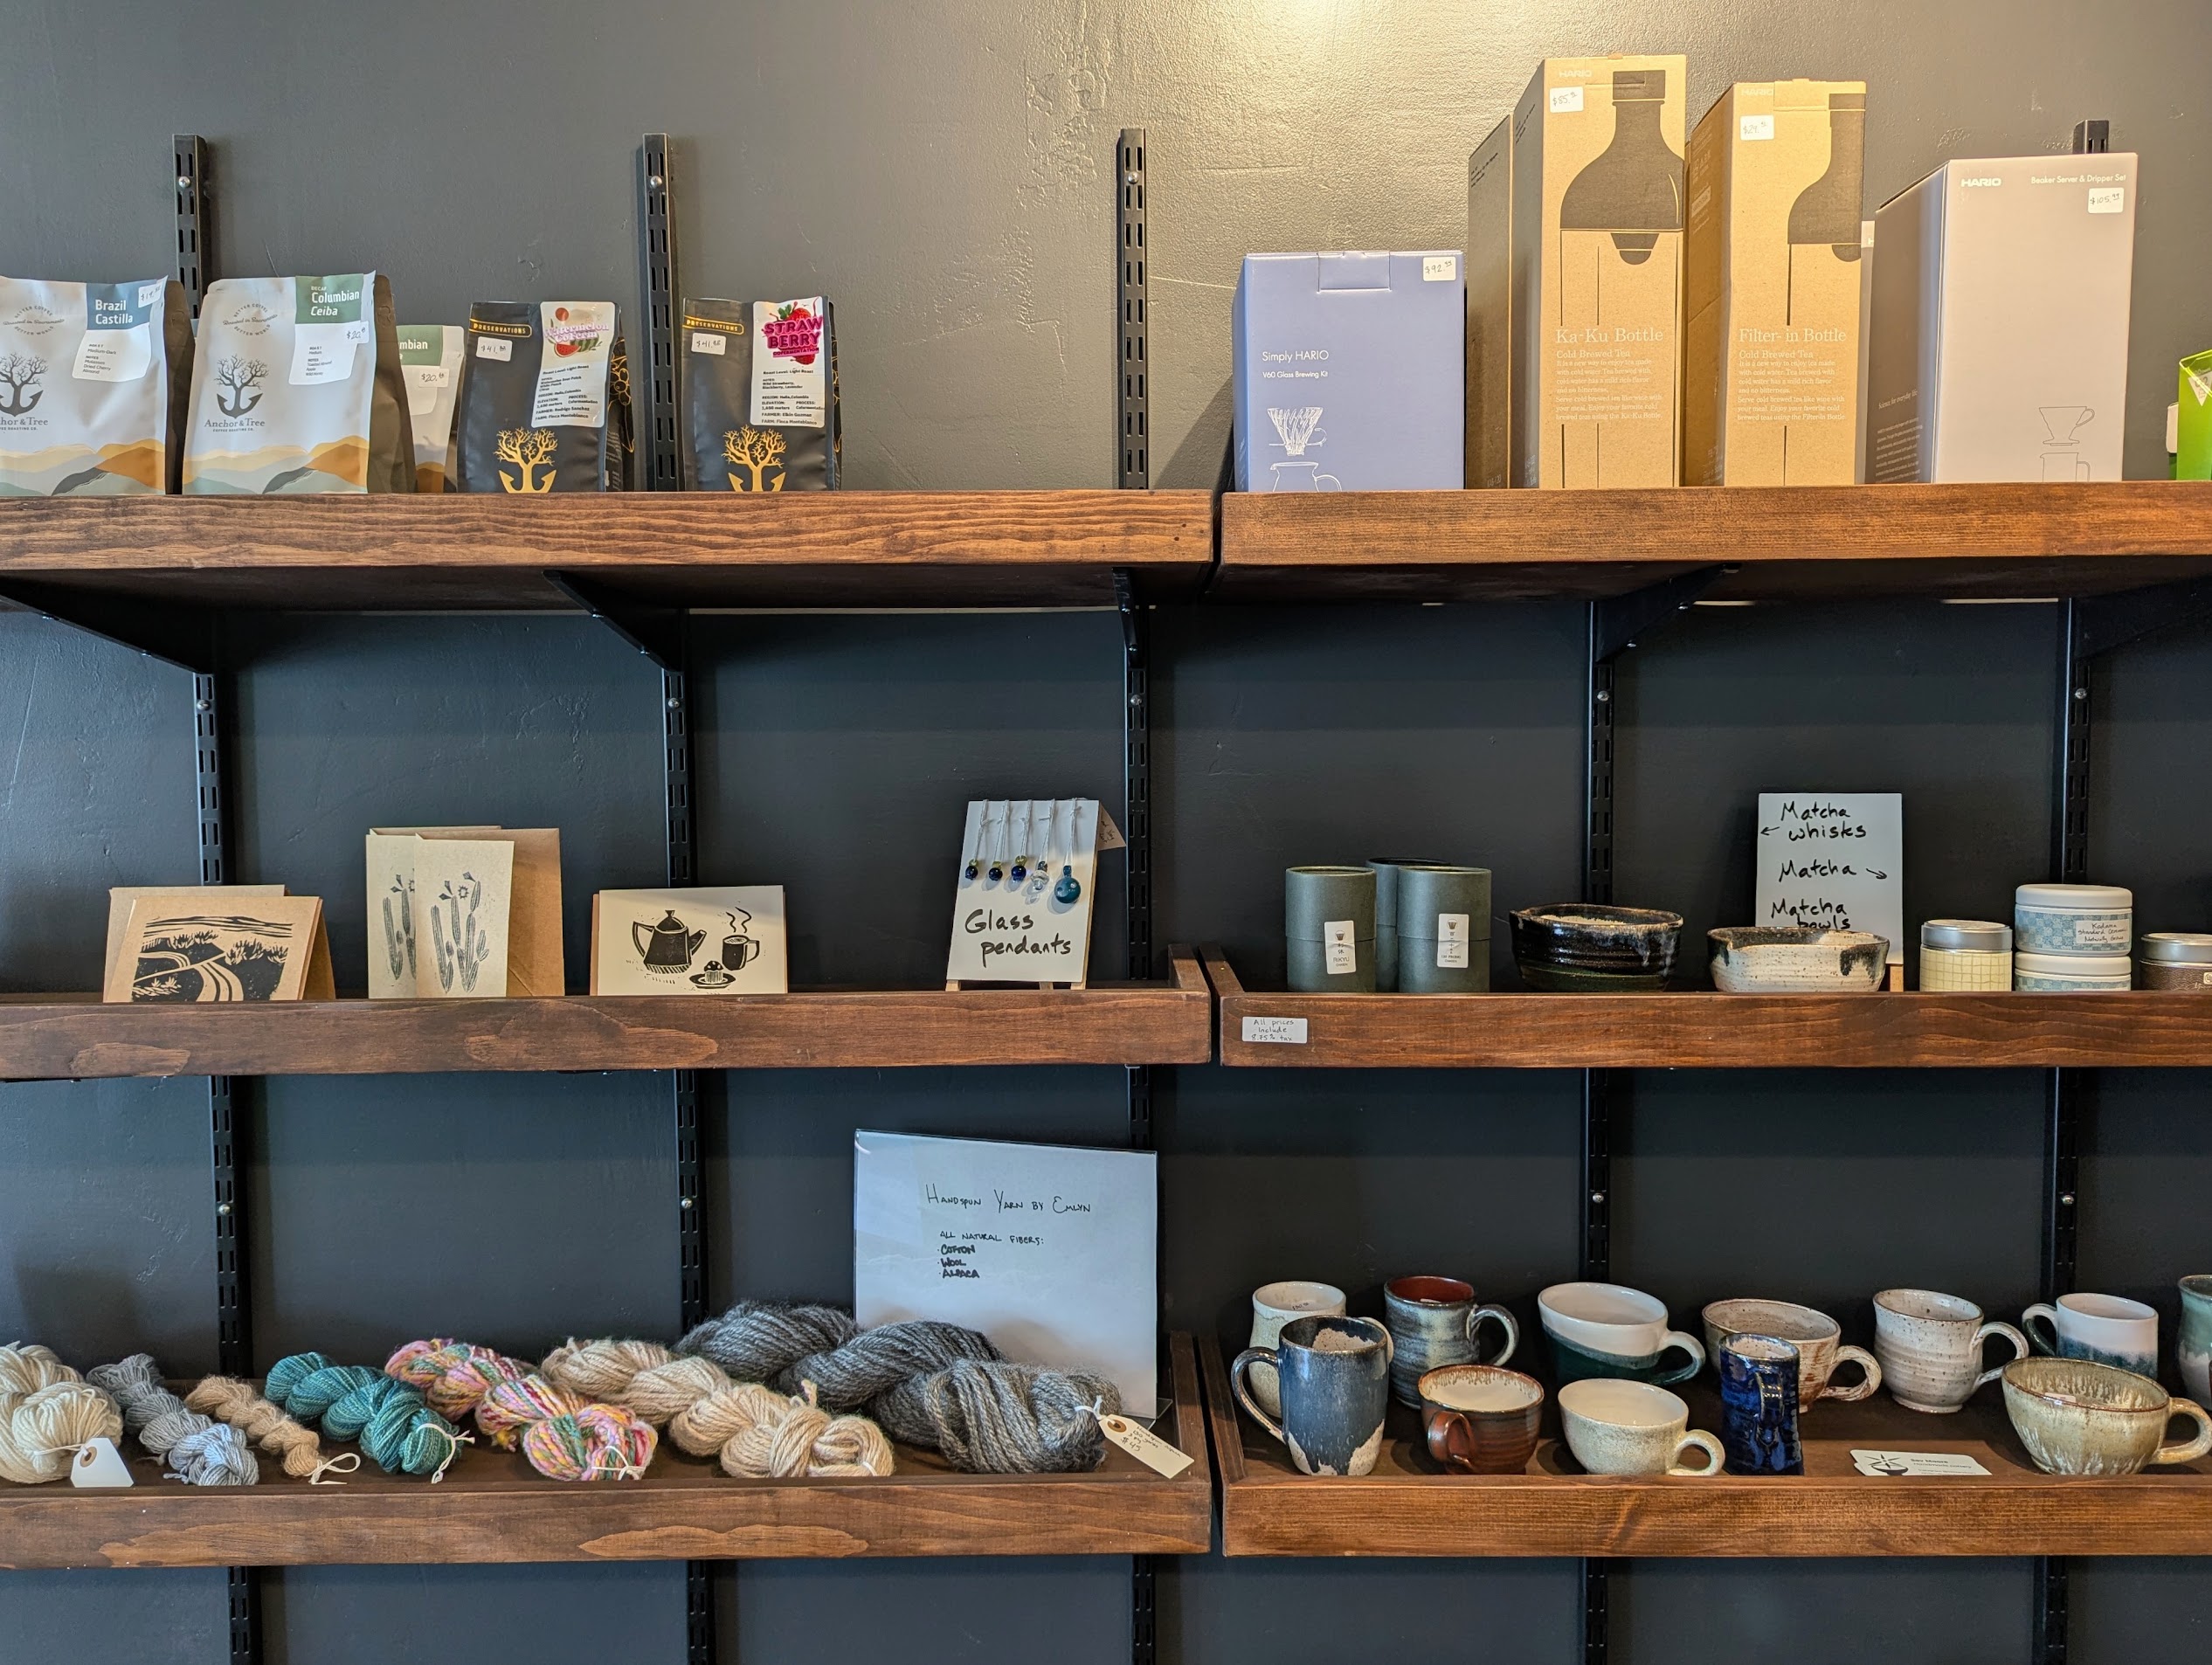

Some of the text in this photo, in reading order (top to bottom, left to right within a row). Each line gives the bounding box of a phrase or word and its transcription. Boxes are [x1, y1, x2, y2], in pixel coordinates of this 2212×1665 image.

[1960, 178, 2002, 188] HARIO
[2031, 176, 2056, 184] Beaker
[2086, 175, 2113, 183] Dripper
[311, 289, 360, 303] Columbian
[95, 299, 127, 311] Brazil
[310, 306, 338, 316] Ceiba
[95, 314, 133, 325] Castilla
[686, 319, 738, 332] PRESERVATIONS
[763, 316, 824, 335] STRAW
[473, 322, 527, 335] PRESERVATIONS
[544, 322, 610, 337] Watermelon
[1555, 327, 1663, 343] Ka-Ku Bottle
[1738, 328, 1846, 342] Filter- in Bottle
[398, 339, 428, 350] mbian
[767, 332, 821, 349] BERRY
[1262, 349, 1330, 363] Simply HARIO
[1556, 349, 1631, 359] Cold Brewed Tea
[1738, 350, 1759, 359] Cold
[1797, 349, 1814, 358] Tea
[0, 417, 18, 425] hor
[26, 417, 49, 426] Tree
[204, 418, 239, 428] Anchor
[245, 418, 266, 426] Tree
[1780, 800, 1851, 821] Matcha
[1788, 820, 1867, 841] whisks
[1779, 859, 1856, 883] Matcha
[1771, 897, 1847, 919] Matcha
[964, 908, 1034, 934] Glass
[980, 932, 1071, 968] pendants
[1271, 1019, 1294, 1028] prices
[940, 1231, 1044, 1246] ALL NATURAL FIBERS:
